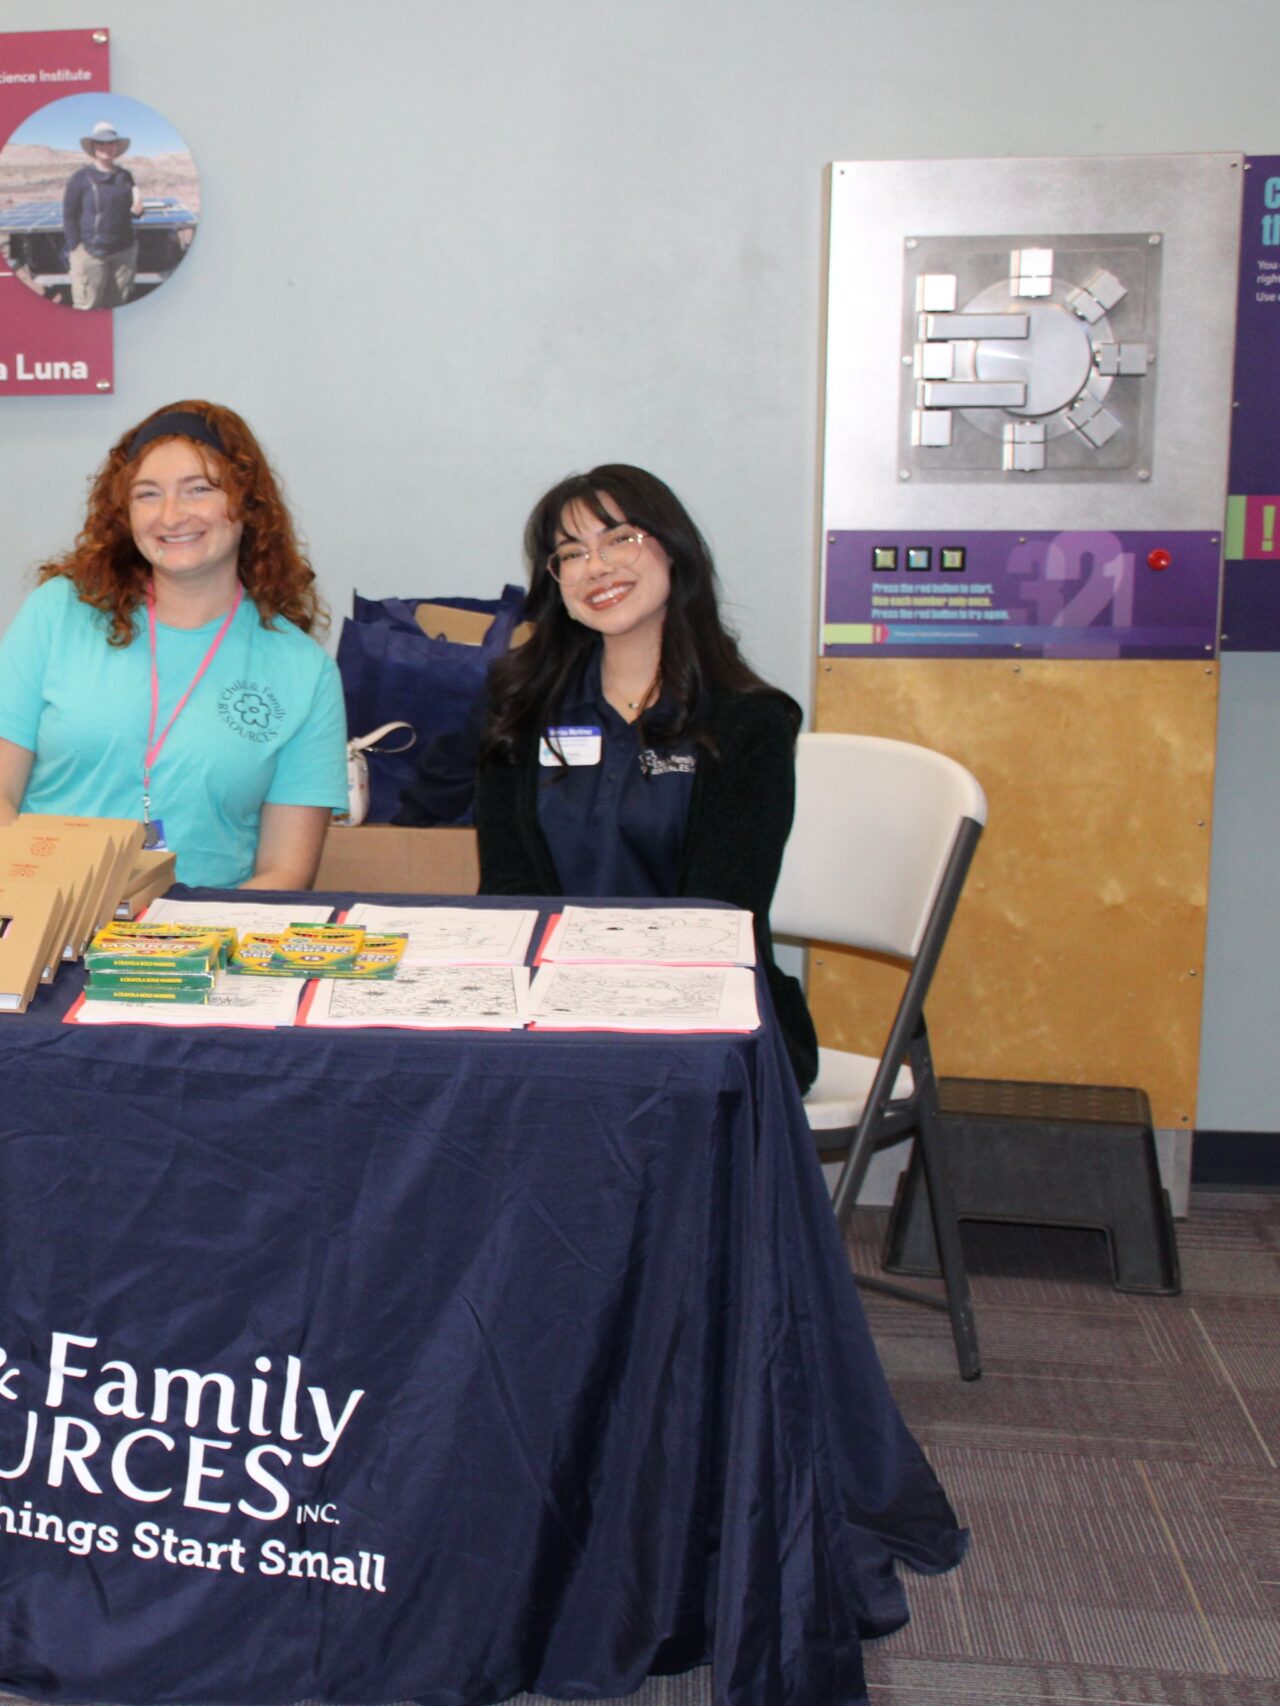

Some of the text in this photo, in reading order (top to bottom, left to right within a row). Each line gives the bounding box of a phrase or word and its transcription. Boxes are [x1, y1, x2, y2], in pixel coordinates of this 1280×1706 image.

[39, 69, 91, 82] Institute
[1255, 292, 1276, 302] Use
[16, 353, 88, 381] Luna
[45, 1332, 365, 1467] Family
[296, 1503, 340, 1525] INC.
[132, 1521, 246, 1573] Start
[259, 1539, 386, 1592] Small
